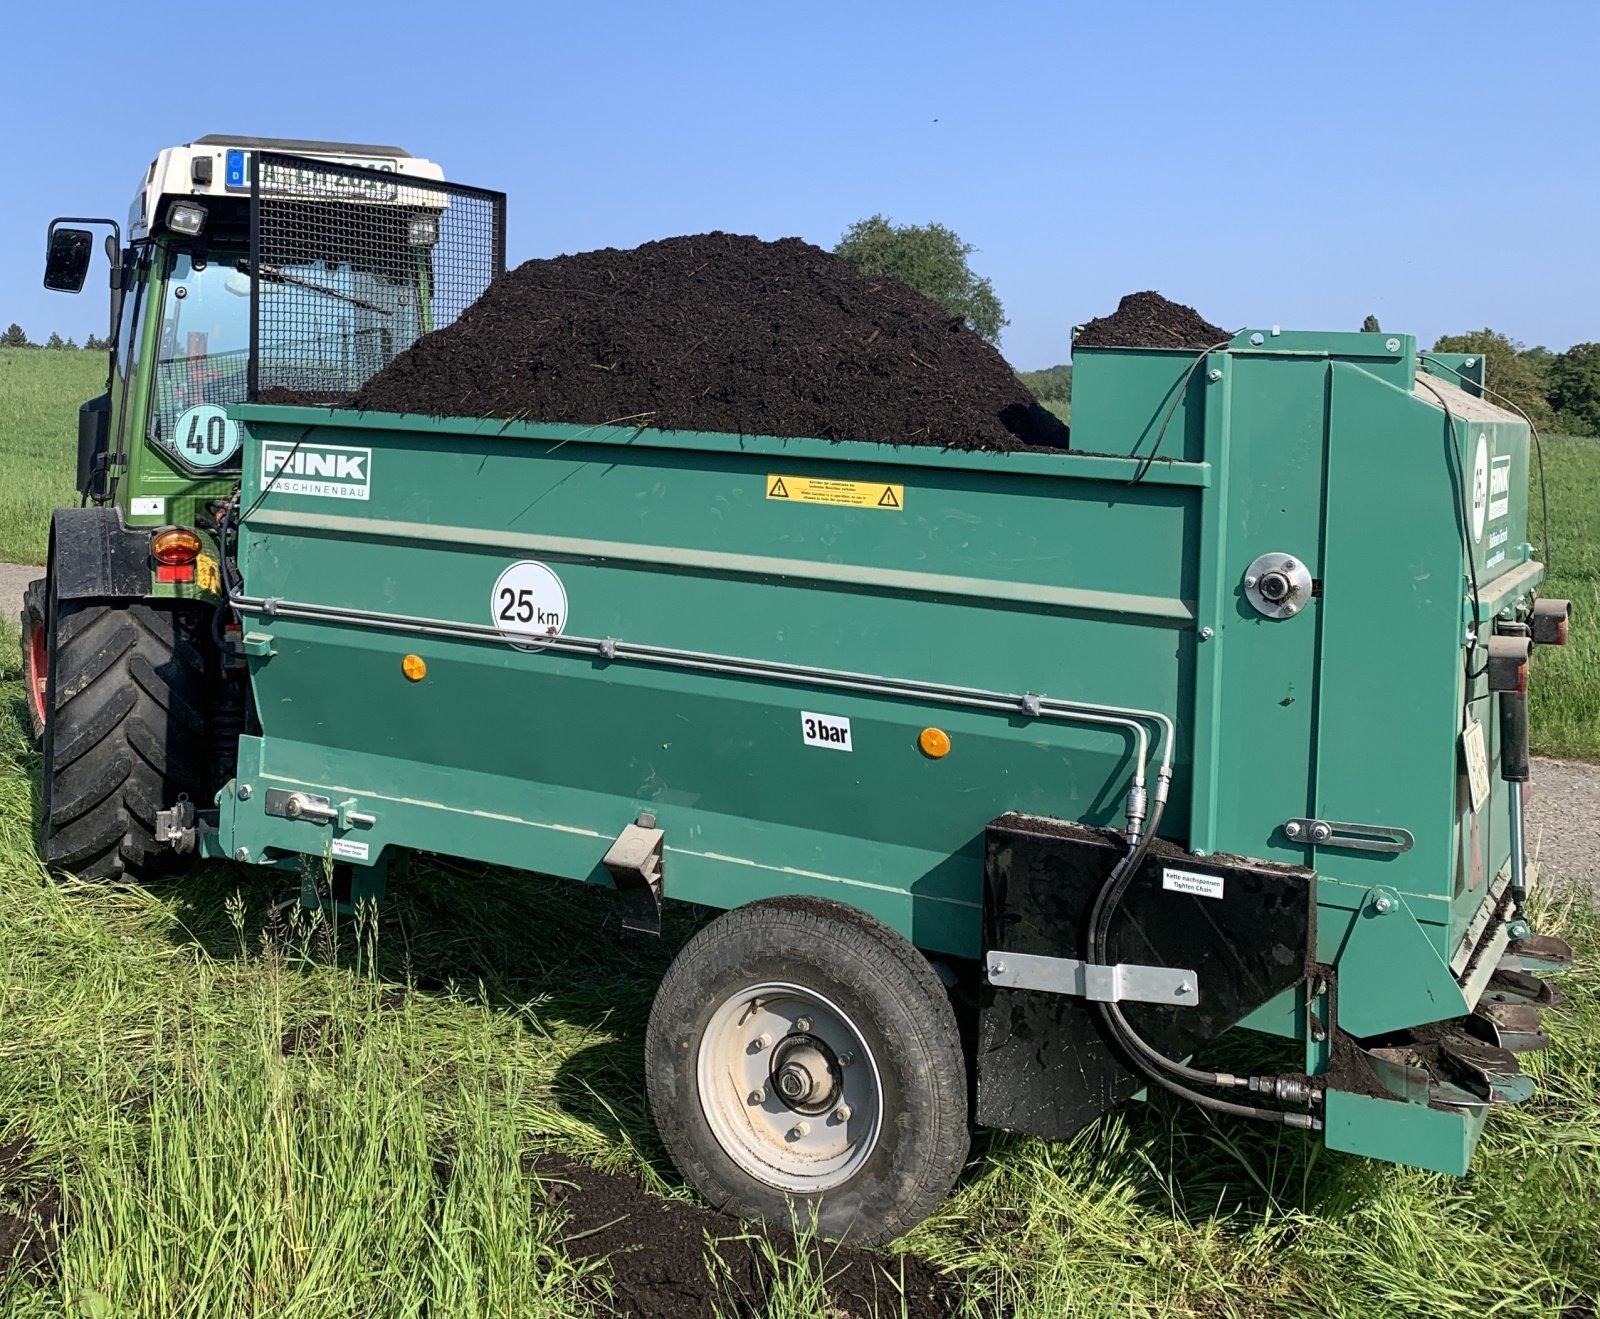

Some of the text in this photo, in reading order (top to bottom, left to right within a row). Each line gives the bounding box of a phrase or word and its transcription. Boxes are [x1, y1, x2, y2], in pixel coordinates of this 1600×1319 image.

[232, 171, 239, 180] D
[186, 415, 226, 456] 40
[265, 450, 367, 480] RINK
[500, 587, 560, 626] 25 km
[805, 718, 848, 744] 3 bar
